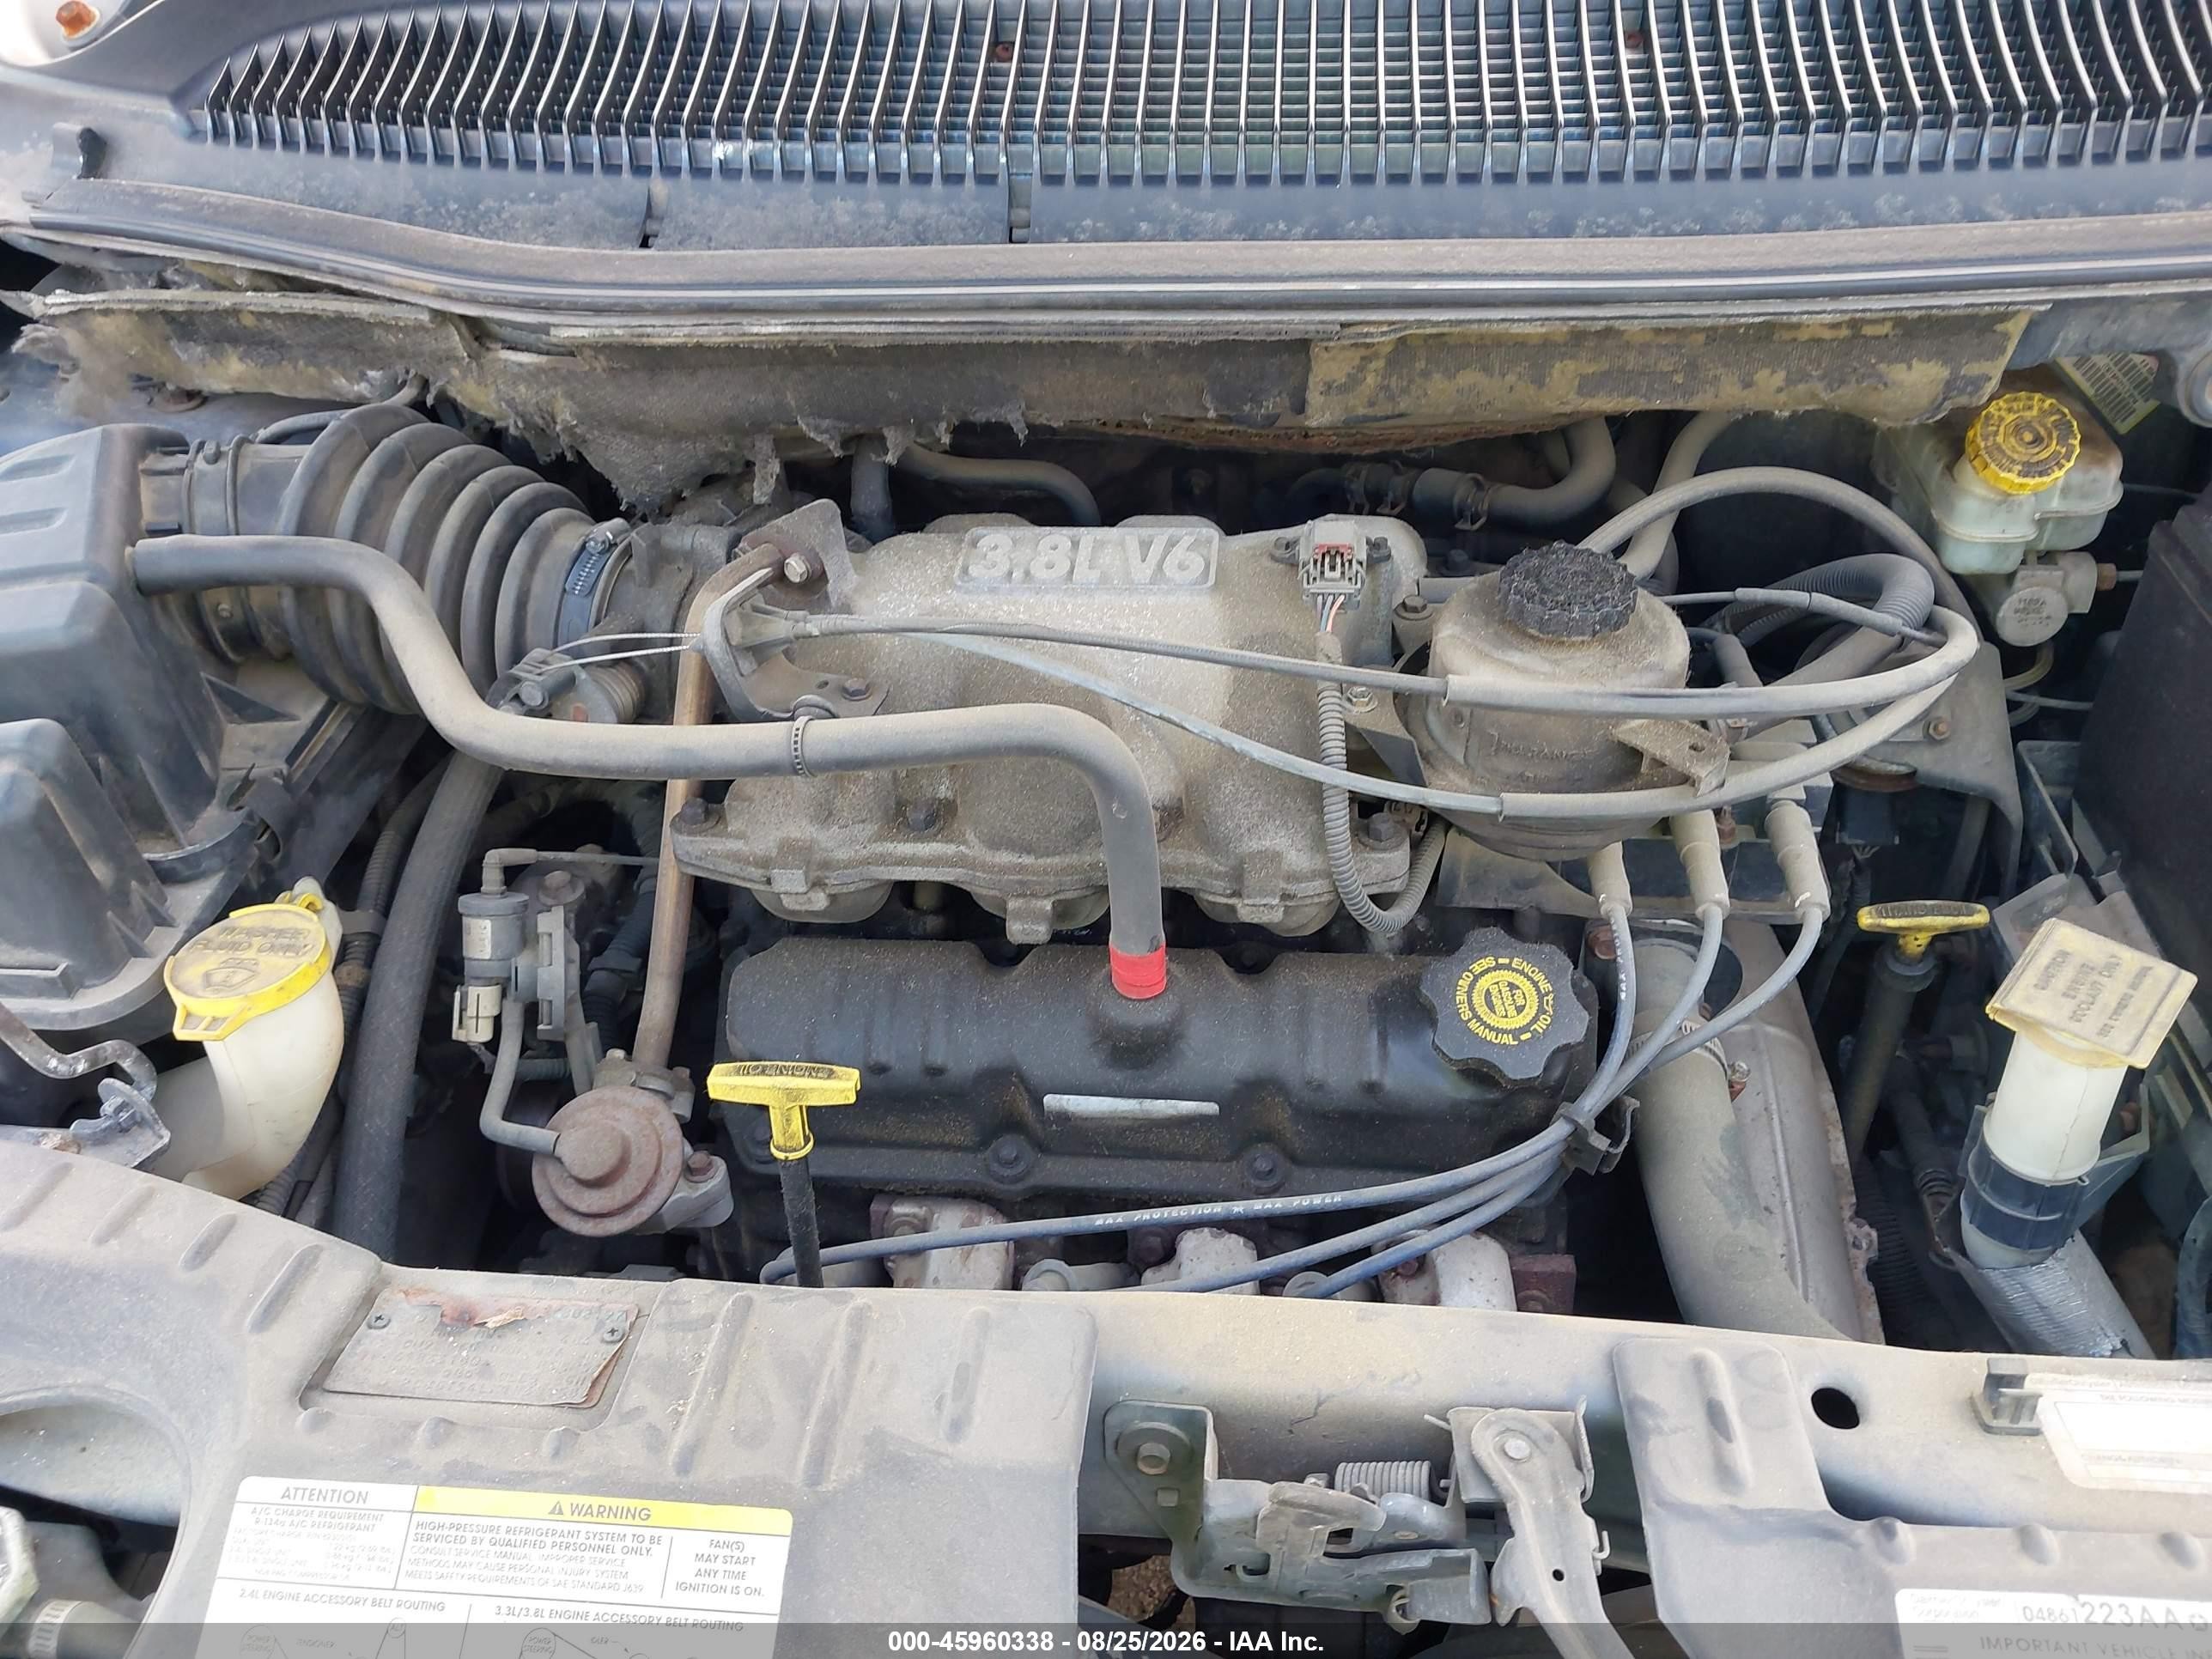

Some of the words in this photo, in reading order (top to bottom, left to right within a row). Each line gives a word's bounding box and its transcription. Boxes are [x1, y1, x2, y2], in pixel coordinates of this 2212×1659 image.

[968, 533, 1102, 585] 3.8L
[1124, 534, 1206, 583] V6
[218, 926, 311, 941] WASHER
[189, 939, 252, 953] FLUID
[258, 942, 317, 957] ONLY
[1469, 956, 1497, 975] SEE
[1511, 957, 1553, 994] ENGINE
[1455, 971, 1474, 1021] OWNERS
[2068, 976, 2105, 1024] COOLANT
[2100, 954, 2124, 979] ONLY
[1467, 1018, 1519, 1046] MANUAL
[1530, 1014, 1553, 1035] OIL
[1133, 1205, 1223, 1222] PROTECTION
[1292, 1194, 1342, 1207] POWER
[281, 1486, 369, 1504] ATTENTION
[251, 1507, 271, 1516] A/C
[274, 1508, 314, 1518] CHARGE
[318, 1510, 385, 1522] REQUIREMENT
[570, 1503, 652, 1522] WARNING
[310, 1520, 377, 1532] REFRIGERANT
[416, 1520, 502, 1535] HIGH-PRESSURE
[505, 1525, 582, 1540] REFRIGERANT
[585, 1531, 627, 1543] SYSTEM
[631, 1533, 646, 1544] TO
[649, 1534, 663, 1545] BE
[413, 1532, 467, 1545] SERVICED
[471, 1535, 485, 1546] BY
[489, 1537, 547, 1549] QUALIFIED
[550, 1540, 617, 1554] PERSONNEL
[621, 1545, 653, 1557] ONLY.
[708, 1539, 745, 1553] FAN(S)
[410, 1545, 452, 1556] CONSULT
[588, 1556, 626, 1568] SERVICE
[694, 1553, 720, 1564] MAY
[722, 1555, 757, 1566] START
[453, 1560, 473, 1570] MAY
[477, 1561, 506, 1572] CAUSE
[595, 1569, 629, 1580] SYSTEM
[694, 1568, 720, 1579] ANY
[722, 1570, 748, 1581] TIME
[572, 1581, 621, 1592] STANDARD
[675, 1581, 727, 1594] IGNITION
[731, 1585, 741, 1595] IS
[744, 1586, 765, 1598] ON.
[240, 1588, 261, 1600] 2.4L
[263, 1589, 301, 1602] ENGINE
[303, 1593, 368, 1607] ACCESSORY
[371, 1596, 393, 1608] BELT
[396, 1598, 446, 1612] ROUTING
[495, 1605, 545, 1619] 3.3L/3.8L
[549, 1608, 591, 1621] ENGINE
[592, 1611, 662, 1626] ACCESSORY
[665, 1616, 690, 1628] BELT
[692, 1619, 744, 1632] ROUTING
[1979, 1635, 2089, 1655] IMPORTANT
[2096, 1641, 2177, 1659] VEHICLE
